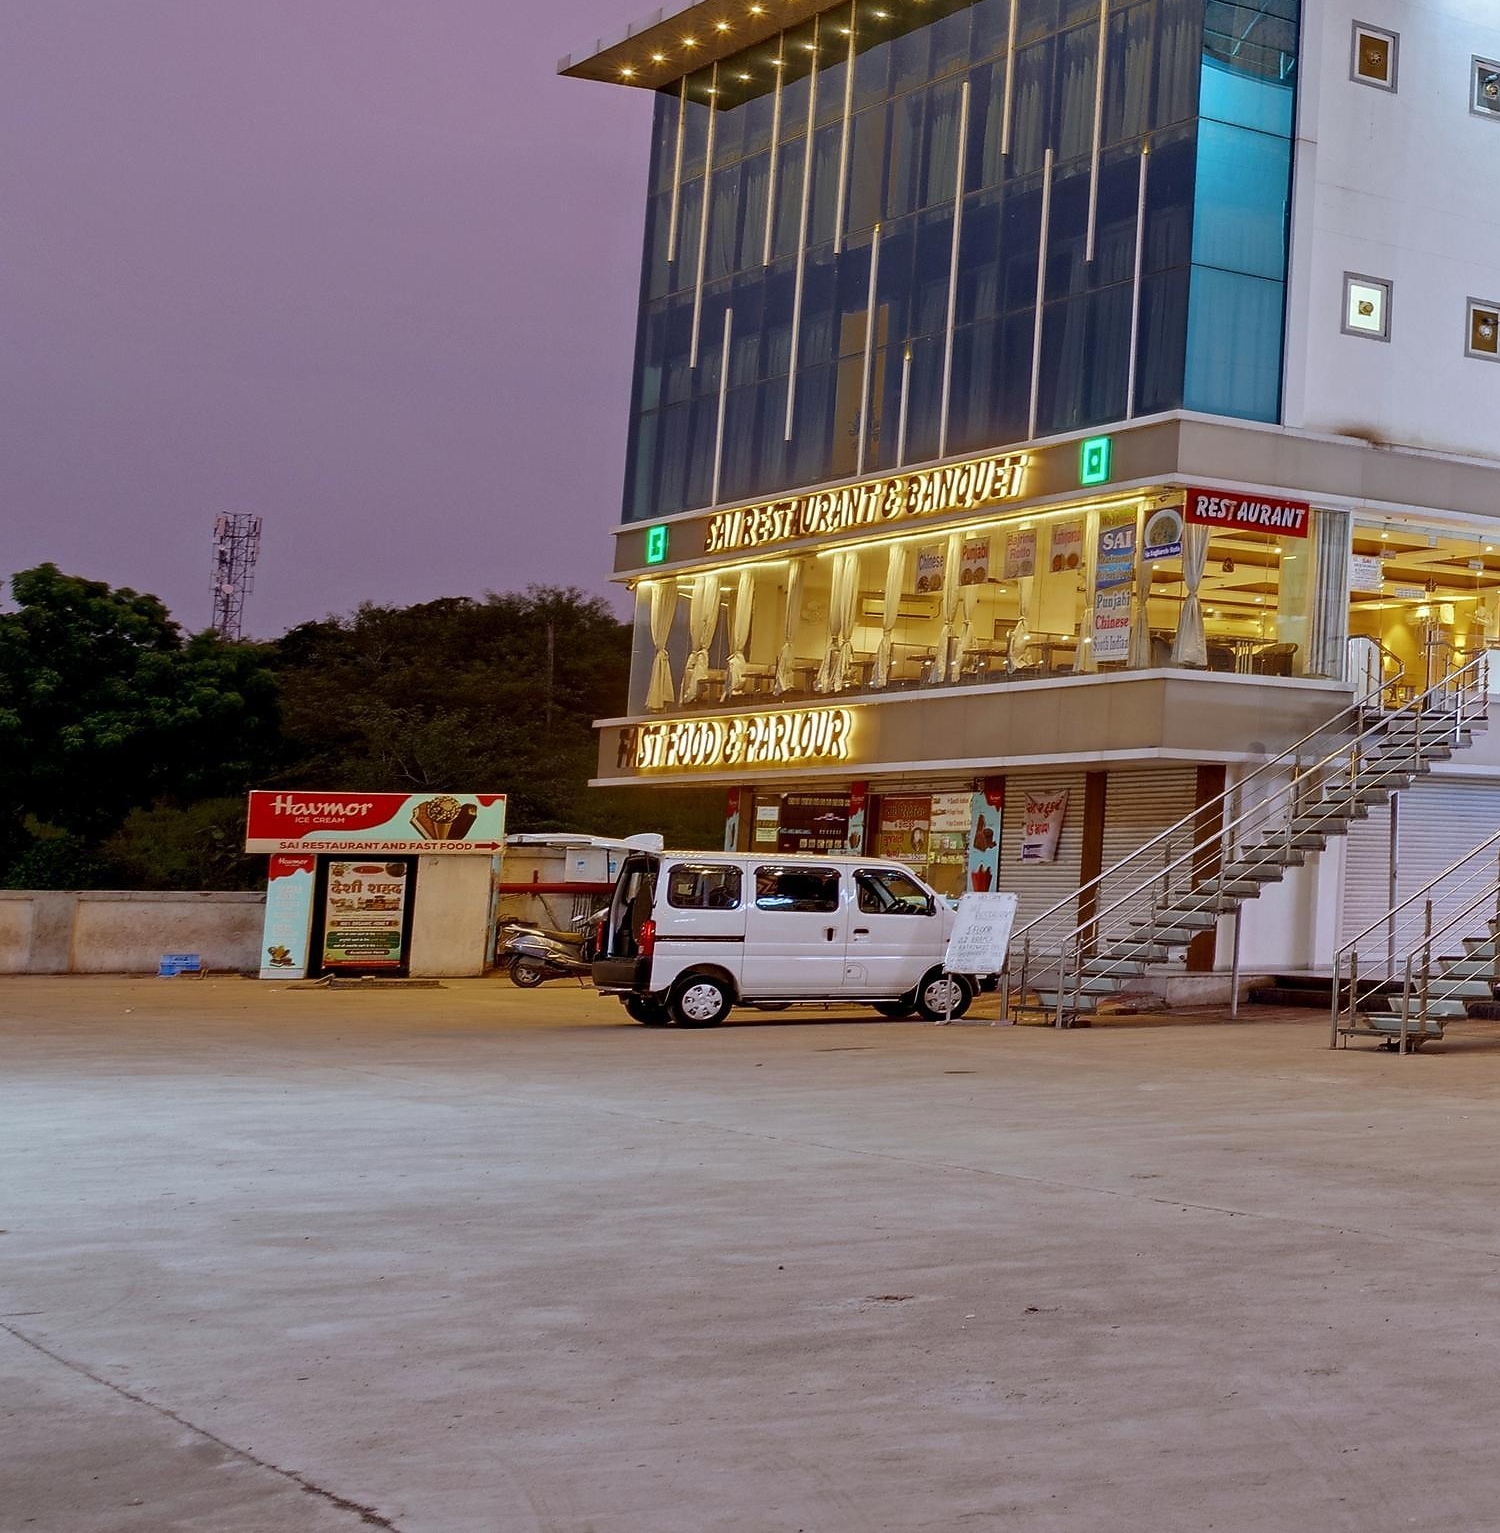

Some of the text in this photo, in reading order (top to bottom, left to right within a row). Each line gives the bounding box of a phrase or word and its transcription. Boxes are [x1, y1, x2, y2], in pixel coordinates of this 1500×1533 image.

[704, 454, 1029, 553] SAI RESTAURANT & BANQUET
[1195, 495, 1306, 529] RESTAURANT
[1103, 530, 1133, 550] SAI
[962, 542, 987, 563] Punjabi
[1096, 591, 1131, 610] Punjabi
[1095, 614, 1129, 631] Chinese
[617, 708, 852, 770] FAST FOOD & PARLOUR
[269, 795, 374, 816] Havmor
[279, 841, 473, 852] SAI RESTAURANT AND FAST FOOD
